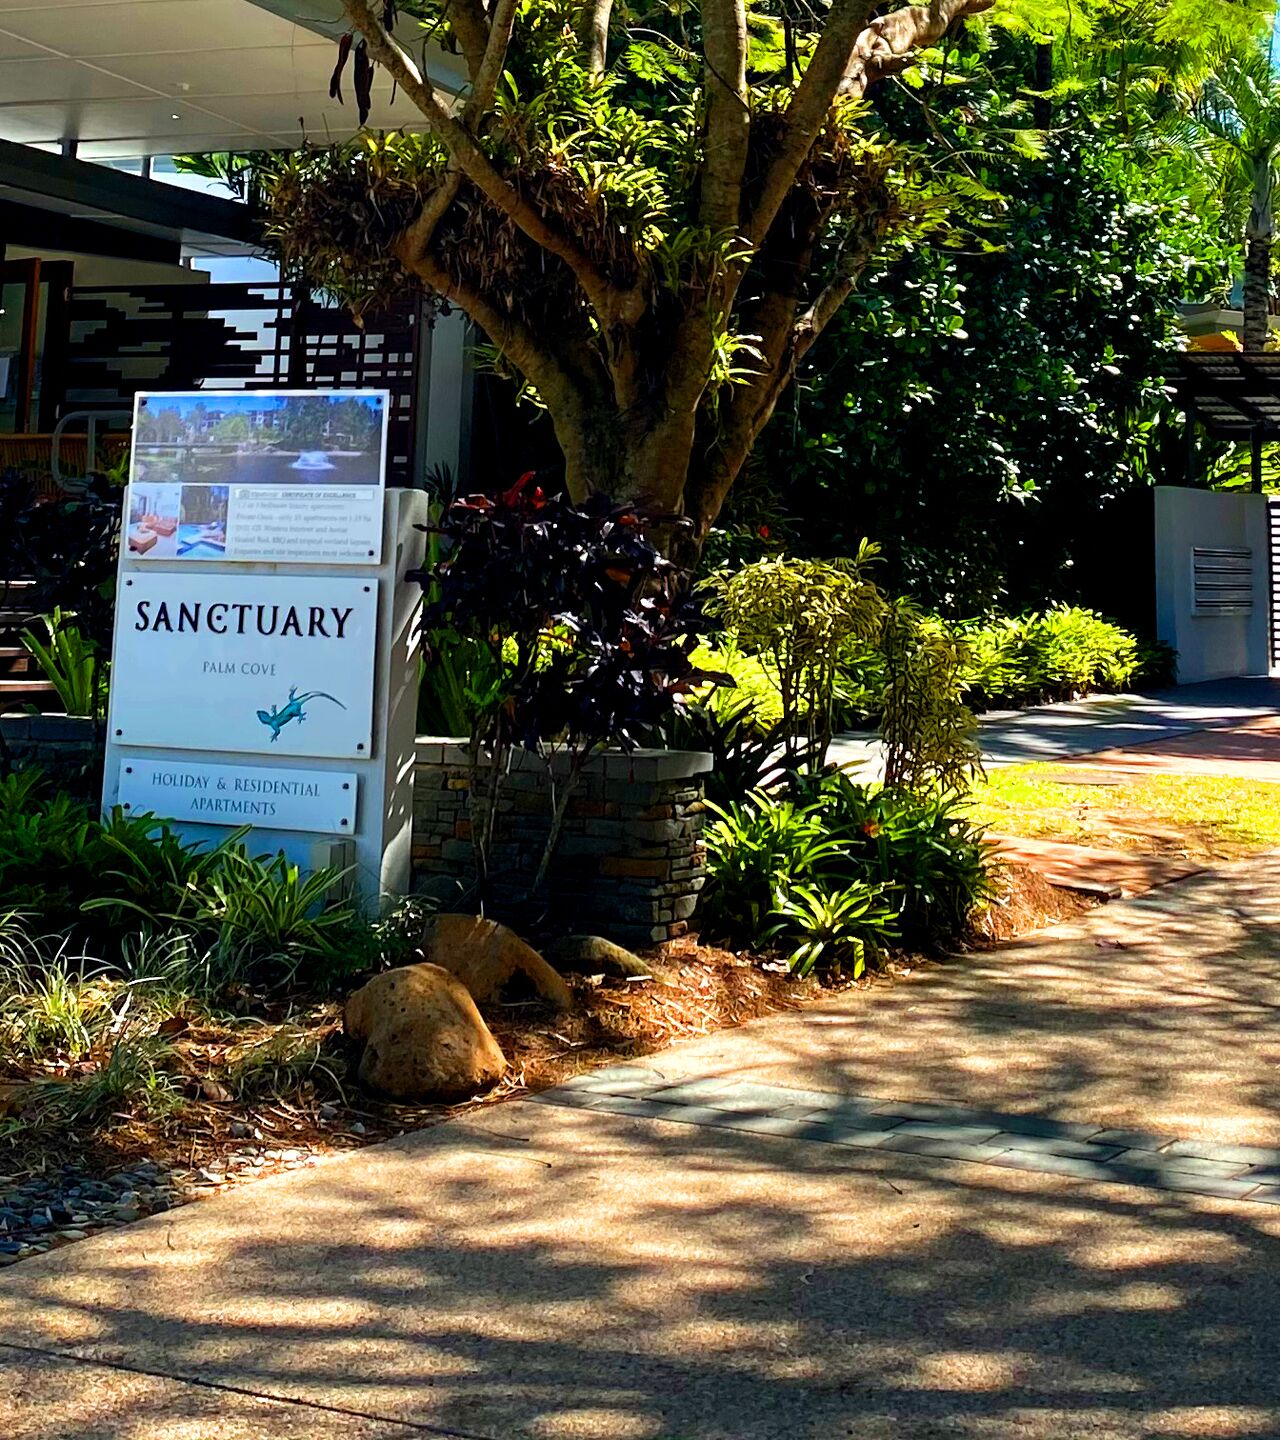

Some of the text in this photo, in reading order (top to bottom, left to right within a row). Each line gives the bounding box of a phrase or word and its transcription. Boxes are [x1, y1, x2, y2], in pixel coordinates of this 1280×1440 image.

[135, 600, 354, 639] SANCTUARY
[202, 660, 277, 677] PALM COVE
[151, 772, 321, 798] HOLIDAY & RESIDENTIAL
[190, 797, 277, 817] APARTMENTS
